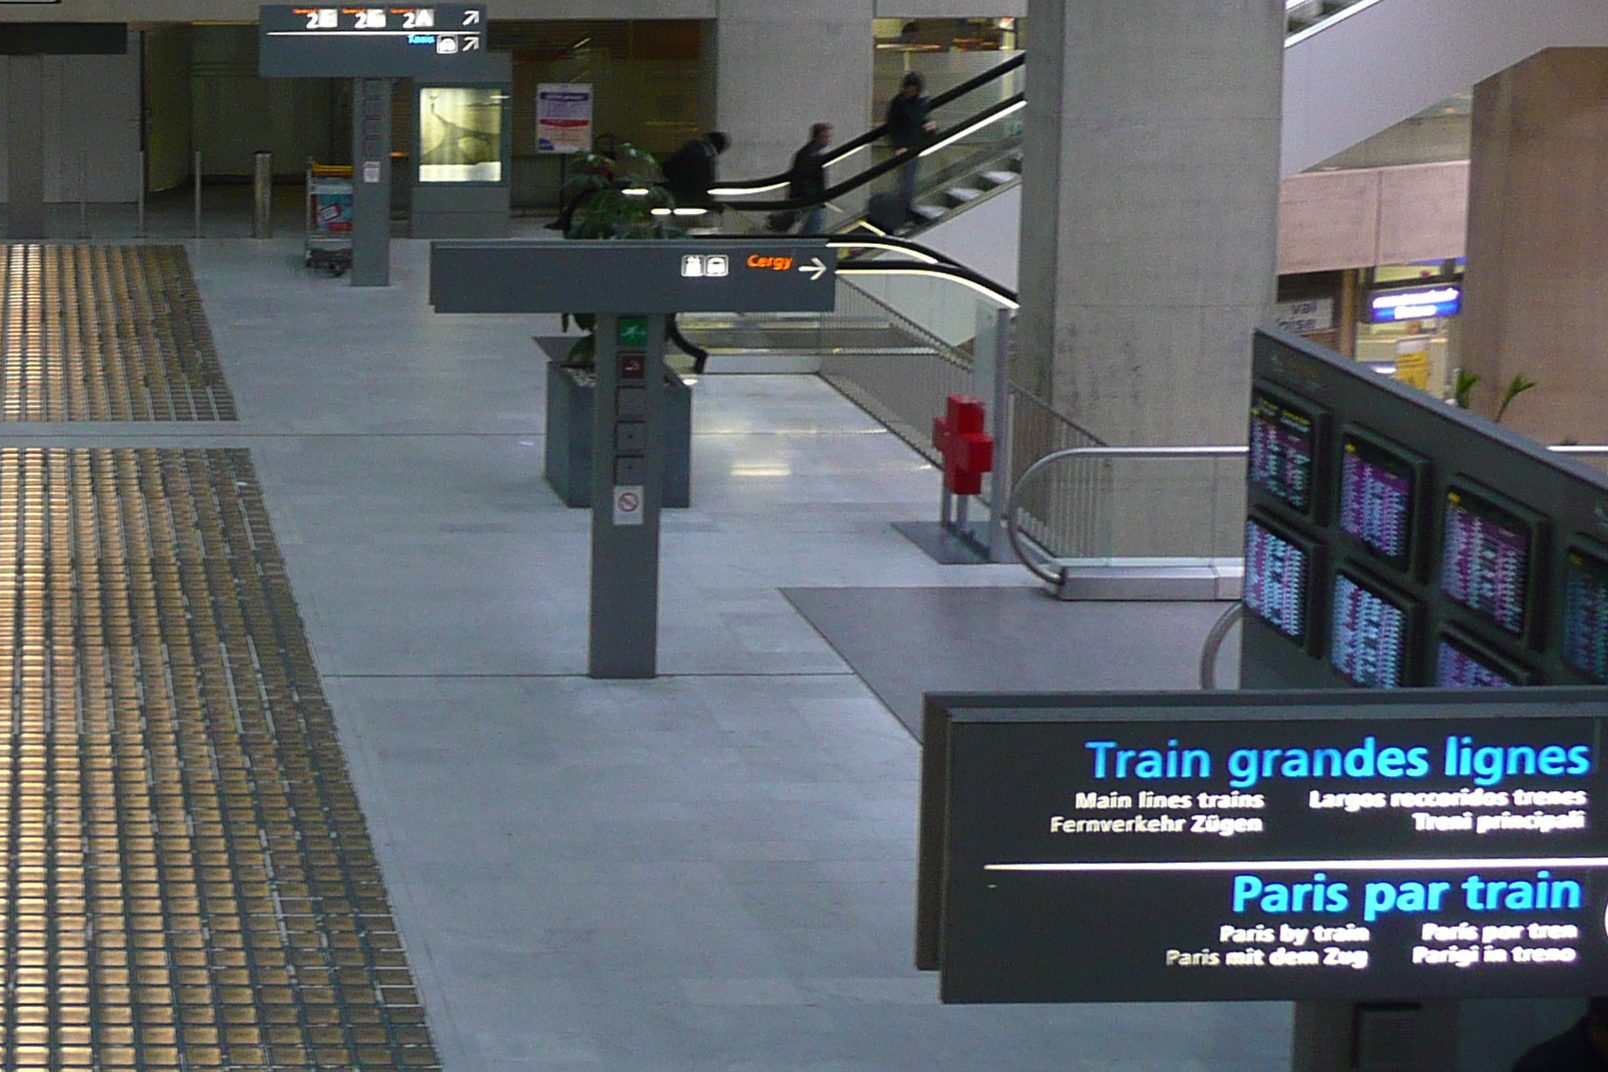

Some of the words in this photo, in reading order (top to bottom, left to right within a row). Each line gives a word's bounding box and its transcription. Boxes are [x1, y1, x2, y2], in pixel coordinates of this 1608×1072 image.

[747, 254, 793, 270] Cergy
[1085, 739, 1210, 778] Train
[1228, 736, 1429, 788] grandes
[1445, 736, 1590, 785] lignes
[1076, 792, 1132, 808] Main
[1138, 791, 1192, 809] lines
[1197, 791, 1265, 809] trains
[1309, 789, 1386, 812] Largos
[1390, 788, 1509, 807] reccoridos
[1512, 789, 1587, 806] trenes
[1051, 815, 1186, 832] Fernverkehr
[1191, 815, 1263, 836] Zügen
[1412, 812, 1472, 830] Treni
[1476, 811, 1585, 833] principali
[1233, 872, 1348, 912] Paris
[1364, 881, 1450, 921] par
[1461, 871, 1580, 910] train
[1220, 924, 1275, 942] Paris
[1280, 923, 1309, 945] by
[1312, 923, 1369, 942] train
[1482, 925, 1524, 943] por
[1527, 923, 1578, 939] tren
[1166, 948, 1220, 966] Paris
[1225, 948, 1265, 965] mit
[1269, 947, 1319, 965] dem
[1323, 947, 1368, 969] Zug
[1412, 945, 1479, 967] Parigi
[1483, 945, 1508, 962] in
[1511, 946, 1576, 962] treno
